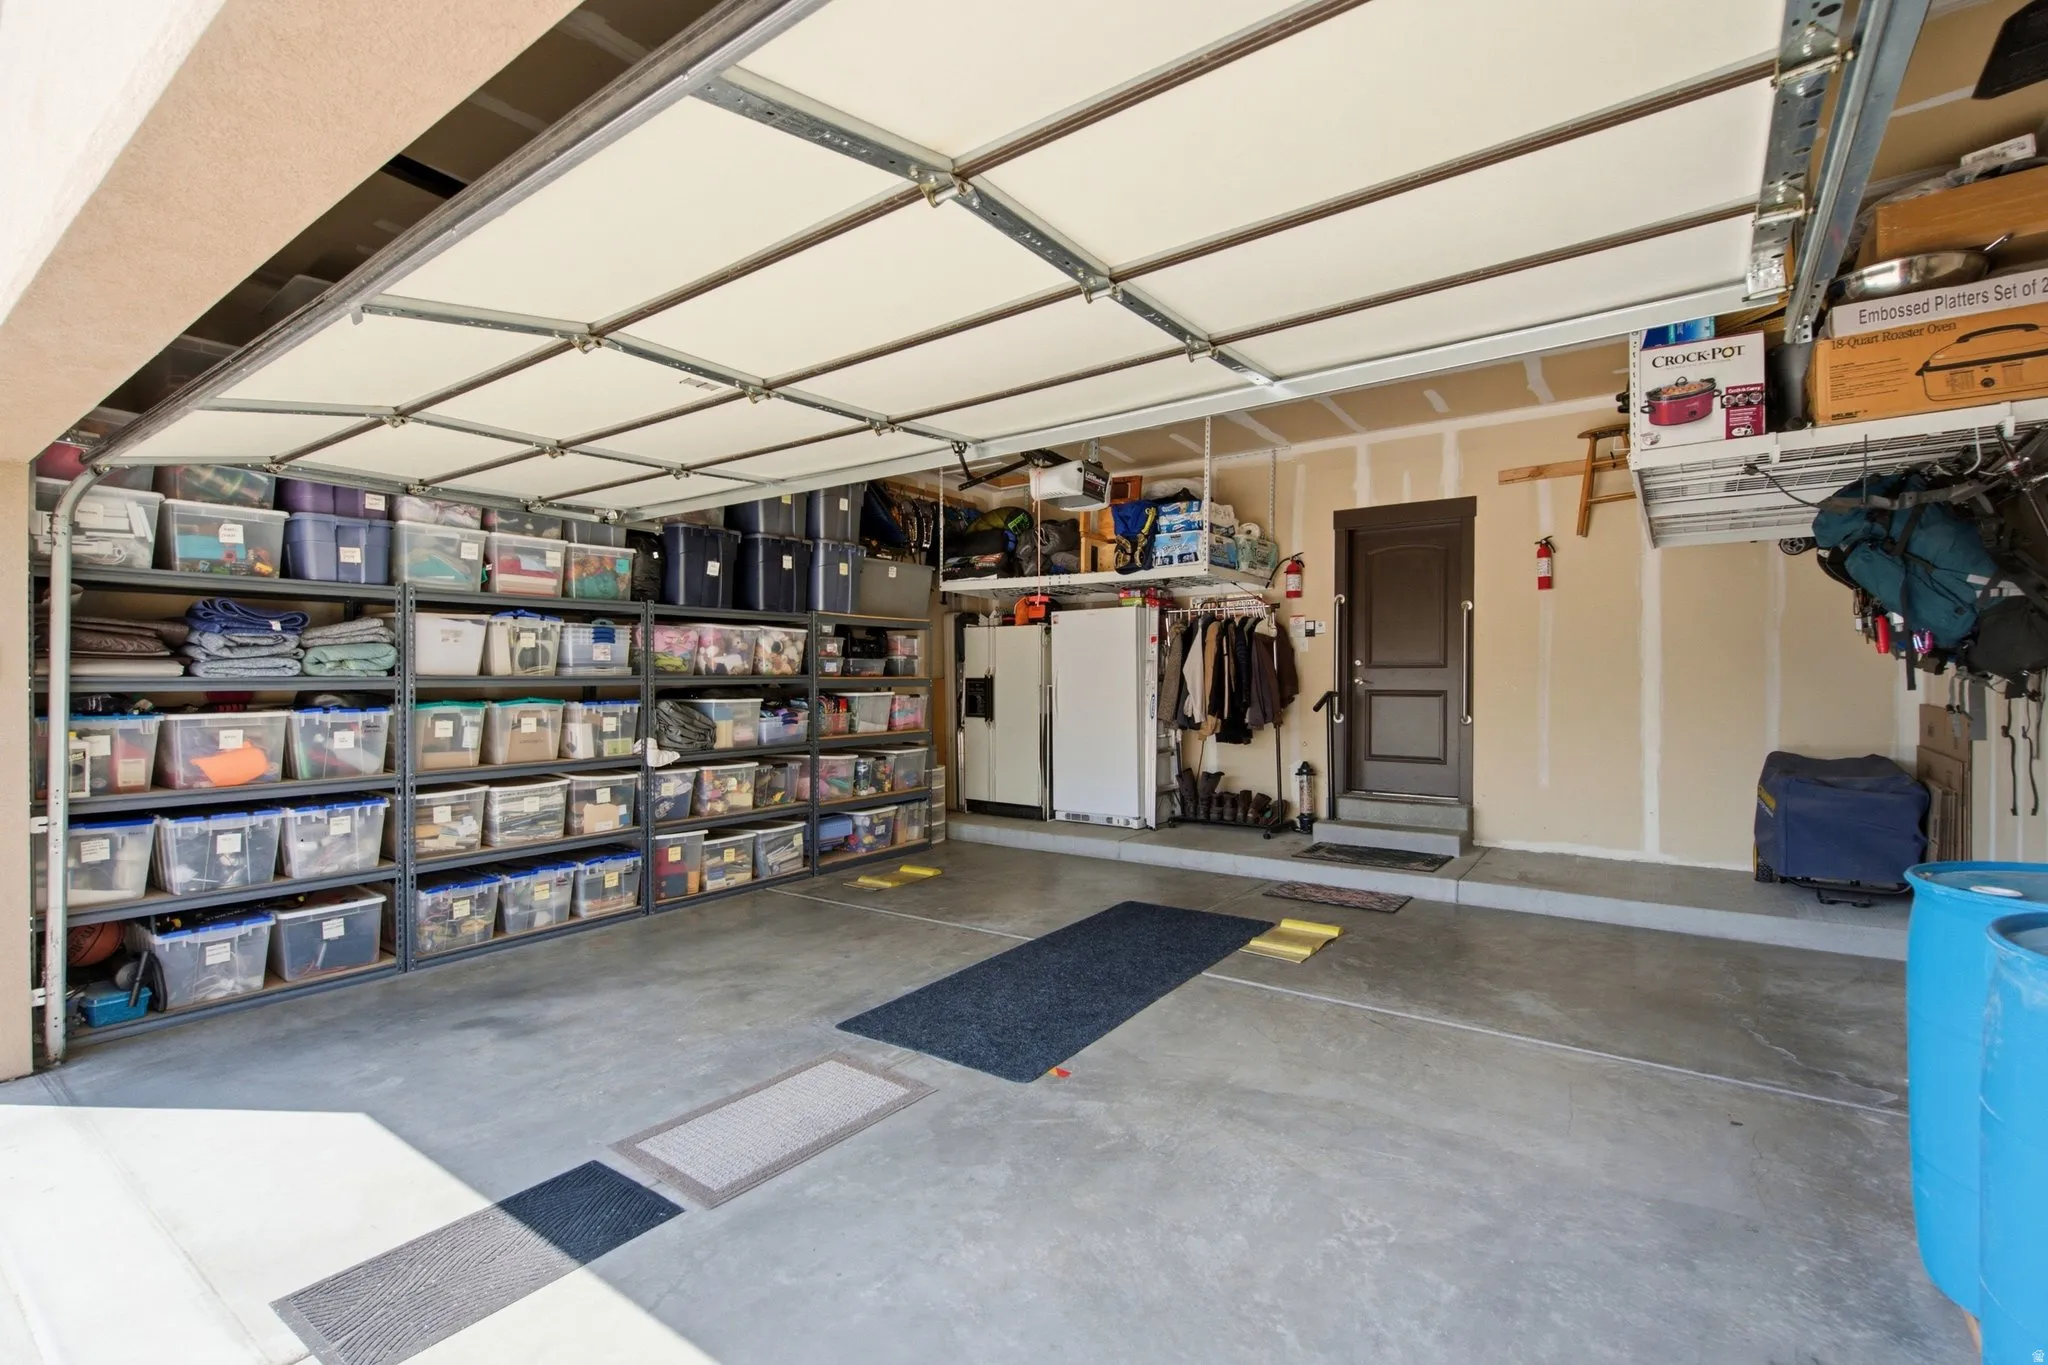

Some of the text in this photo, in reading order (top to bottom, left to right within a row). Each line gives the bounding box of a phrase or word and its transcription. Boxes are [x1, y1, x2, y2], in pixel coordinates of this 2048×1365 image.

[1859, 301, 1929, 324] Embossed
[1935, 289, 1989, 311] Platters
[1994, 284, 2018, 301] Set
[2022, 279, 2038, 297] of
[1831, 321, 1957, 350] 18-Quart Roaster Oven
[1652, 345, 1746, 368] CROCK-POT
